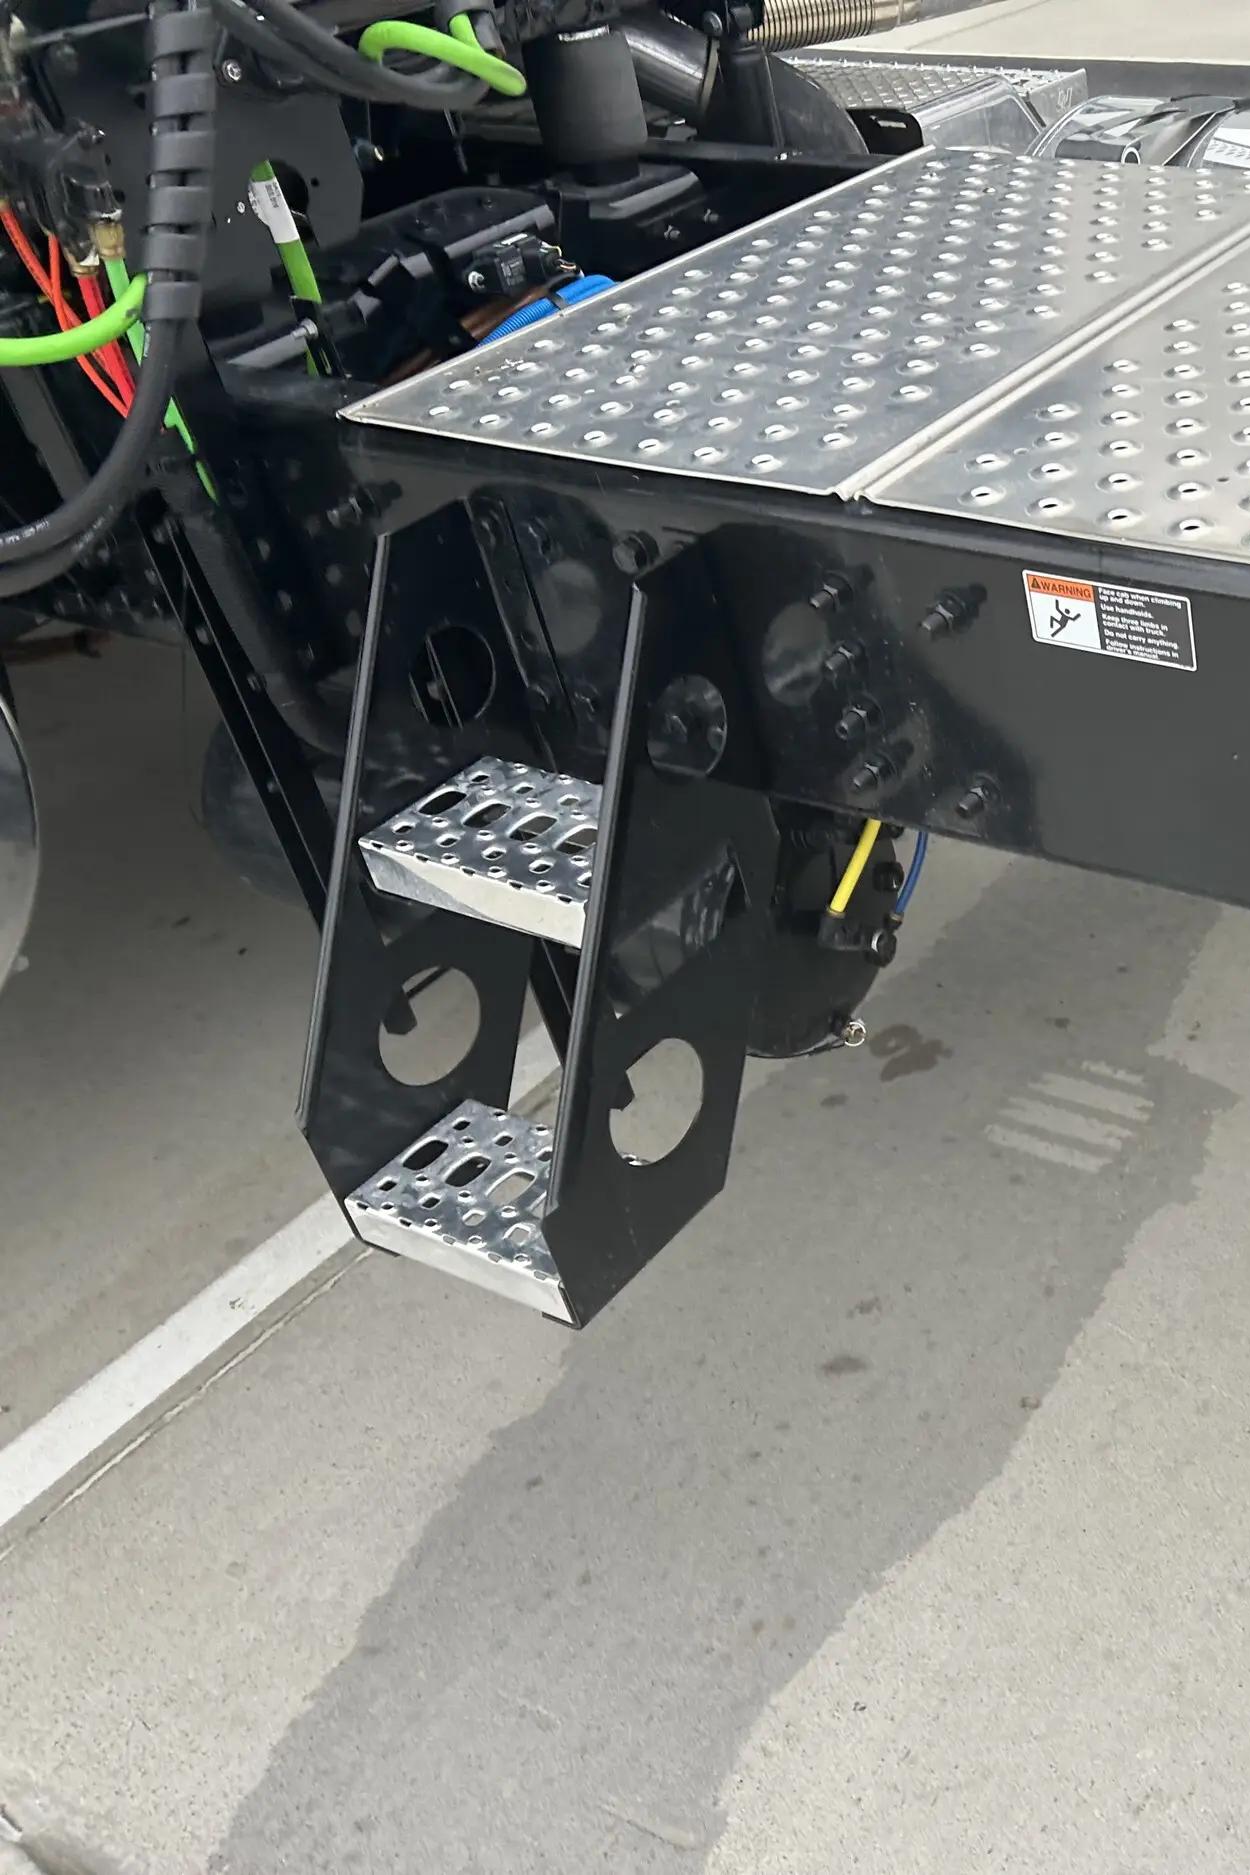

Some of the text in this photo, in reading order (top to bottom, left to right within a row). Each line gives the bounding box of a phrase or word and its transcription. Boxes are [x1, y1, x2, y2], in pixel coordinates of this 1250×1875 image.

[1040, 580, 1092, 598] WARNING
[1098, 587, 1115, 595] Face
[1130, 593, 1150, 602] when
[1151, 597, 1181, 609] climbing
[1100, 603, 1114, 611] Use
[1102, 613, 1120, 622] Keep
[1104, 629, 1114, 637] Do
[1128, 635, 1146, 644] carry
